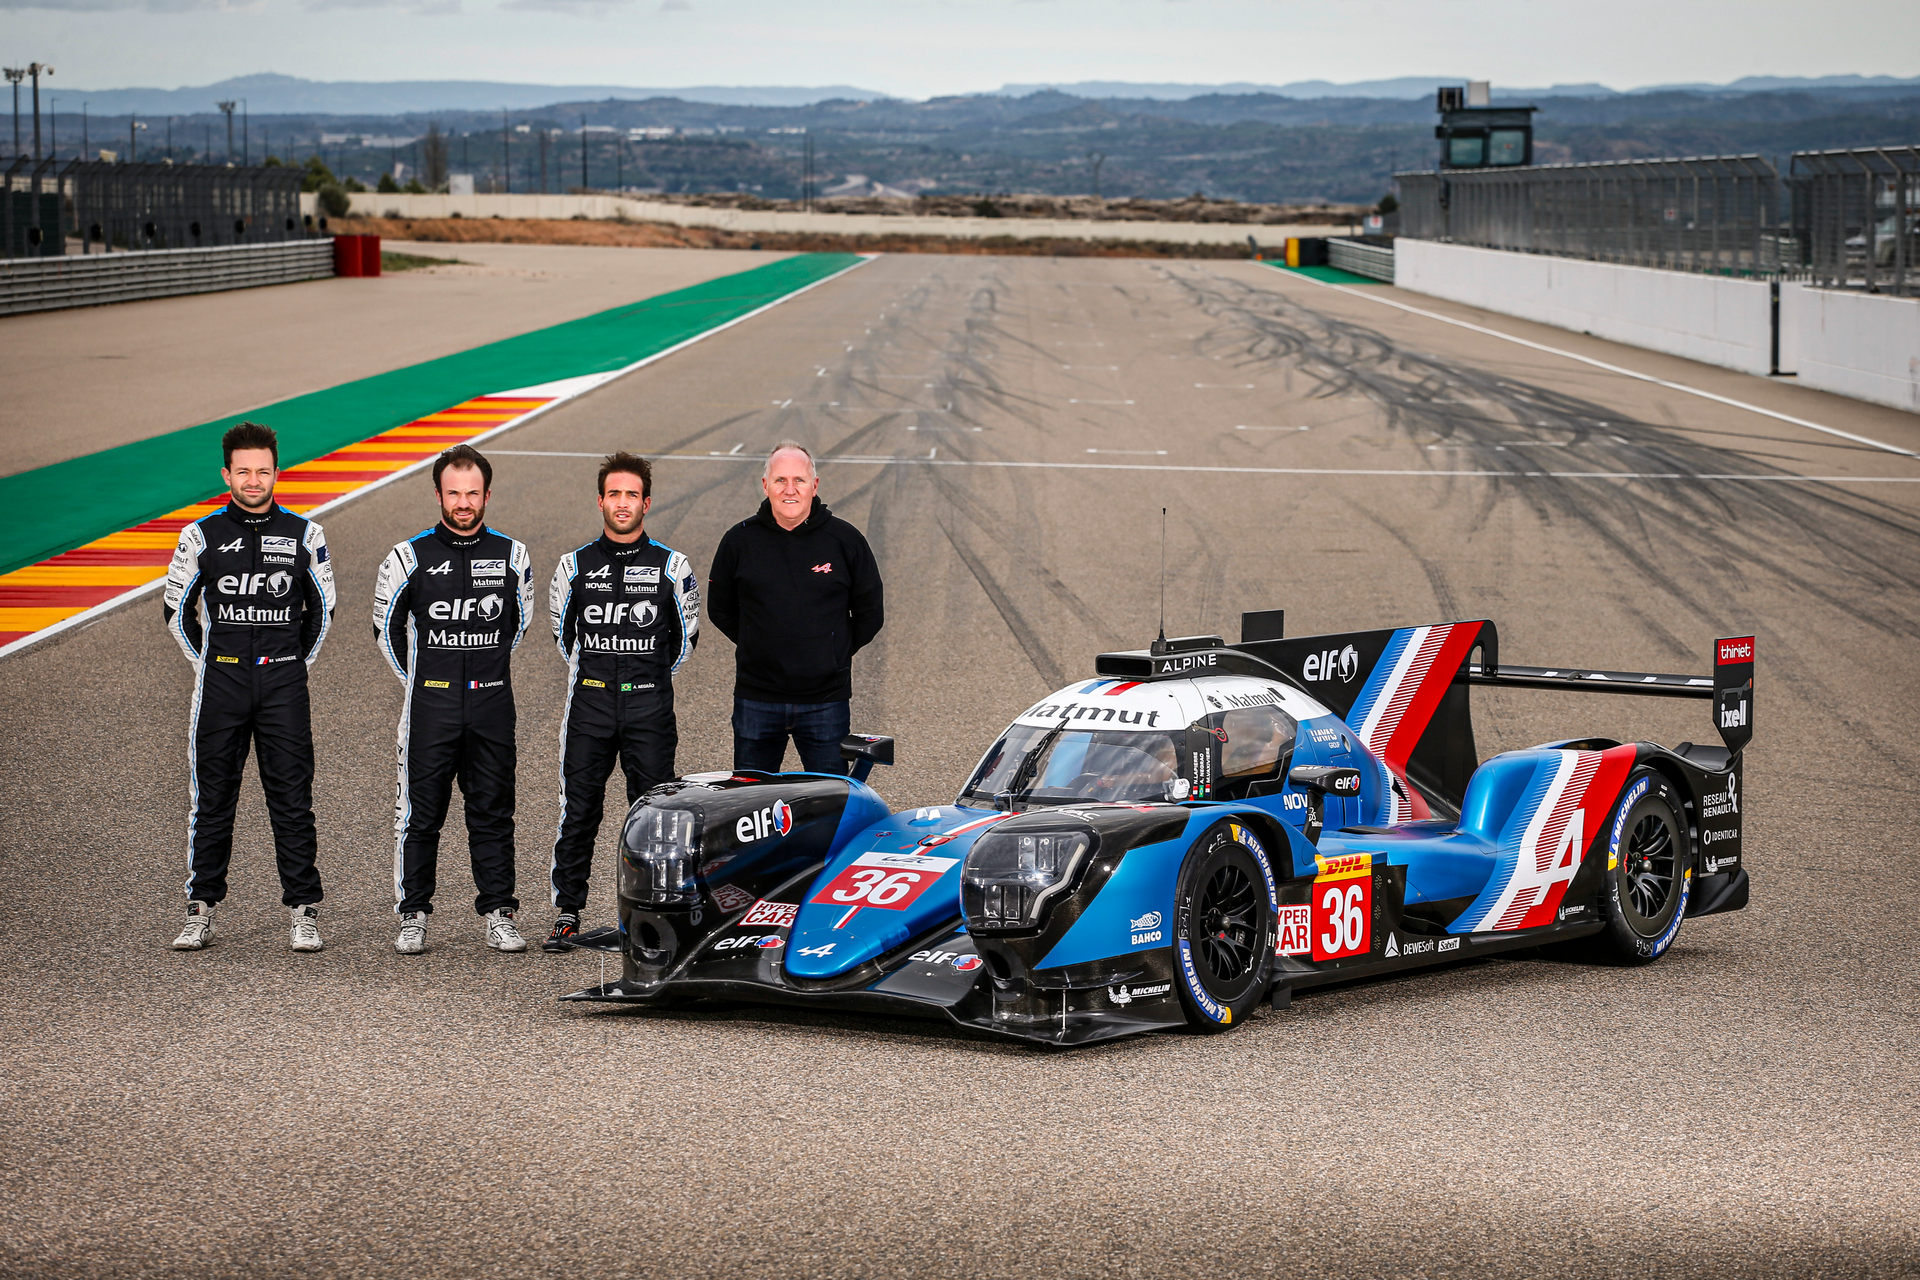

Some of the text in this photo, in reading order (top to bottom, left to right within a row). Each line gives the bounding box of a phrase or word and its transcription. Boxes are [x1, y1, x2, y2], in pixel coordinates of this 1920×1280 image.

[263, 554, 295, 564] Matmut
[473, 561, 505, 570] WEC
[626, 567, 659, 576] WEC
[217, 573, 267, 595] elf
[472, 578, 504, 587] Matmut
[585, 582, 612, 590] NOVAC
[625, 584, 658, 592] Matmut
[218, 603, 291, 622] Matmut
[428, 598, 477, 620] elf
[583, 602, 630, 625] elf
[427, 628, 501, 647] Matmut
[584, 632, 656, 651] Matmut
[1720, 643, 1751, 660] thiriet
[1161, 653, 1218, 673] ALPINE
[1302, 649, 1339, 682] elf
[1223, 690, 1281, 709] Matmut
[1721, 699, 1747, 728] ixell
[1335, 777, 1352, 790] elf
[1283, 793, 1308, 811] NOV
[1703, 791, 1727, 807] RESEAU
[1613, 780, 1646, 841] MICHELIN
[1703, 803, 1732, 818] RENAULT
[736, 806, 772, 843] elf
[1246, 834, 1278, 906] MICHELIN
[1324, 855, 1366, 875] DHL
[831, 869, 922, 905] 36
[755, 902, 800, 913] HYPE
[745, 910, 796, 925] CAR
[1277, 909, 1308, 925] YPER
[1321, 884, 1364, 954] 36
[713, 935, 761, 951] elf
[1131, 930, 1162, 946] BAHCO
[1275, 924, 1309, 950] AR
[1403, 938, 1435, 956] DEWESoft
[907, 949, 959, 965] elf
[1132, 983, 1171, 996] MICHELIN
[1181, 947, 1218, 1016] MICHELIN
